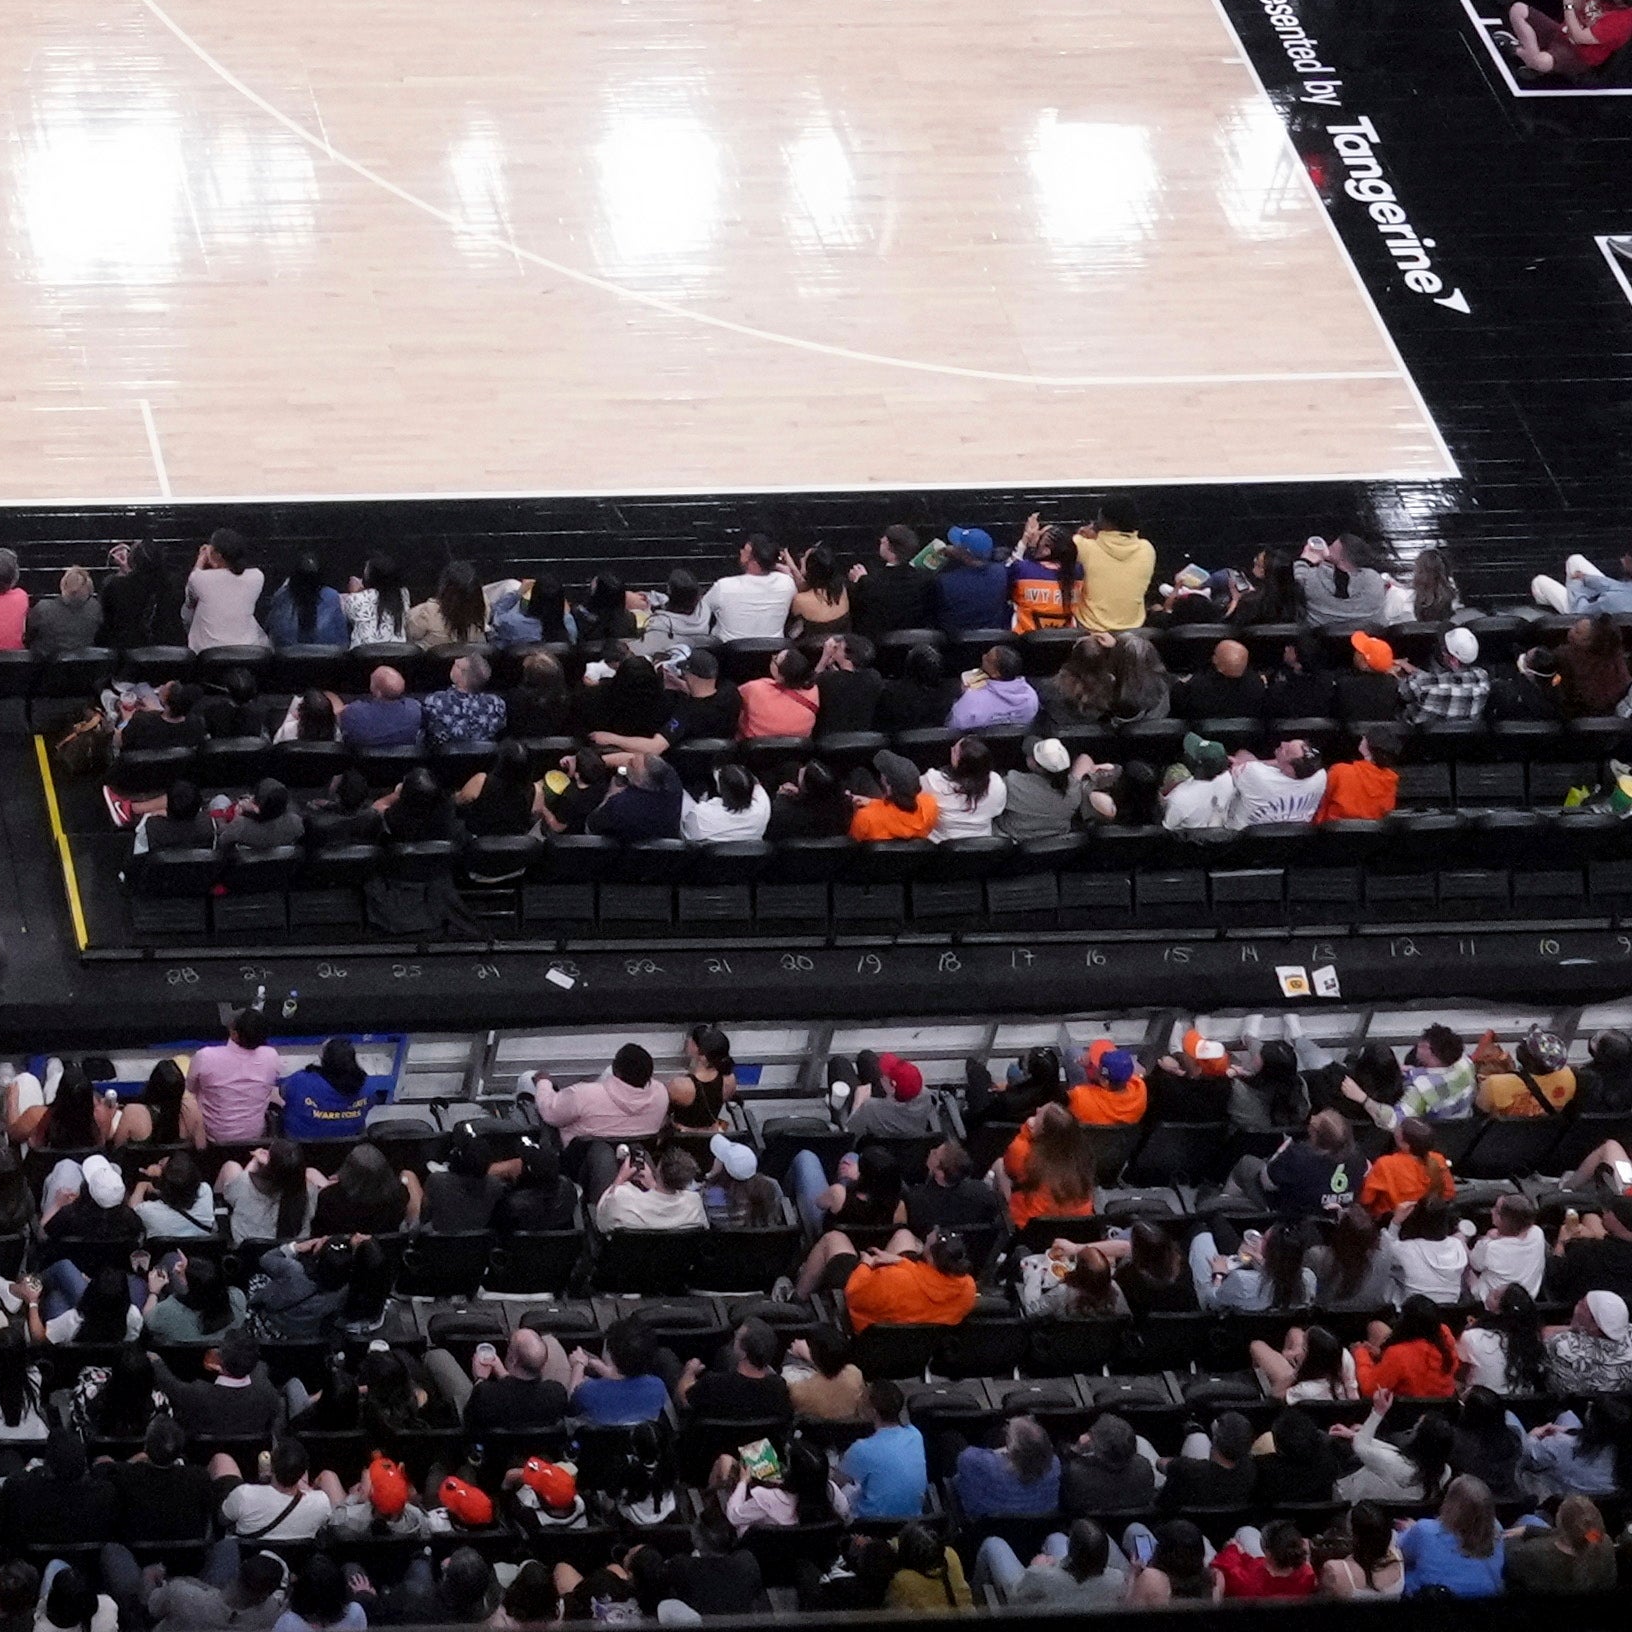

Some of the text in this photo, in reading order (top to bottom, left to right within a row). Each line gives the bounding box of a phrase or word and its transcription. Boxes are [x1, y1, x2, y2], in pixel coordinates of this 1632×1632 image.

[1299, 80, 1343, 106] by
[1324, 115, 1448, 297] Tangerine
[1163, 946, 1194, 963] 15
[1241, 944, 1260, 962] 14
[1311, 942, 1338, 960] 13
[1390, 937, 1422, 957] 12
[1459, 938, 1476, 956] 11
[1539, 938, 1562, 956] 10
[703, 958, 733, 975] 21
[780, 953, 815, 972] 20
[856, 954, 883, 975] 19
[937, 951, 962, 972] 18
[1010, 949, 1036, 969] 17
[1085, 948, 1107, 967] 16
[316, 962, 348, 979] 26
[392, 964, 423, 979] 25
[475, 964, 501, 980] 24
[624, 958, 665, 976] 22
[1330, 1163, 1349, 1194] 6
